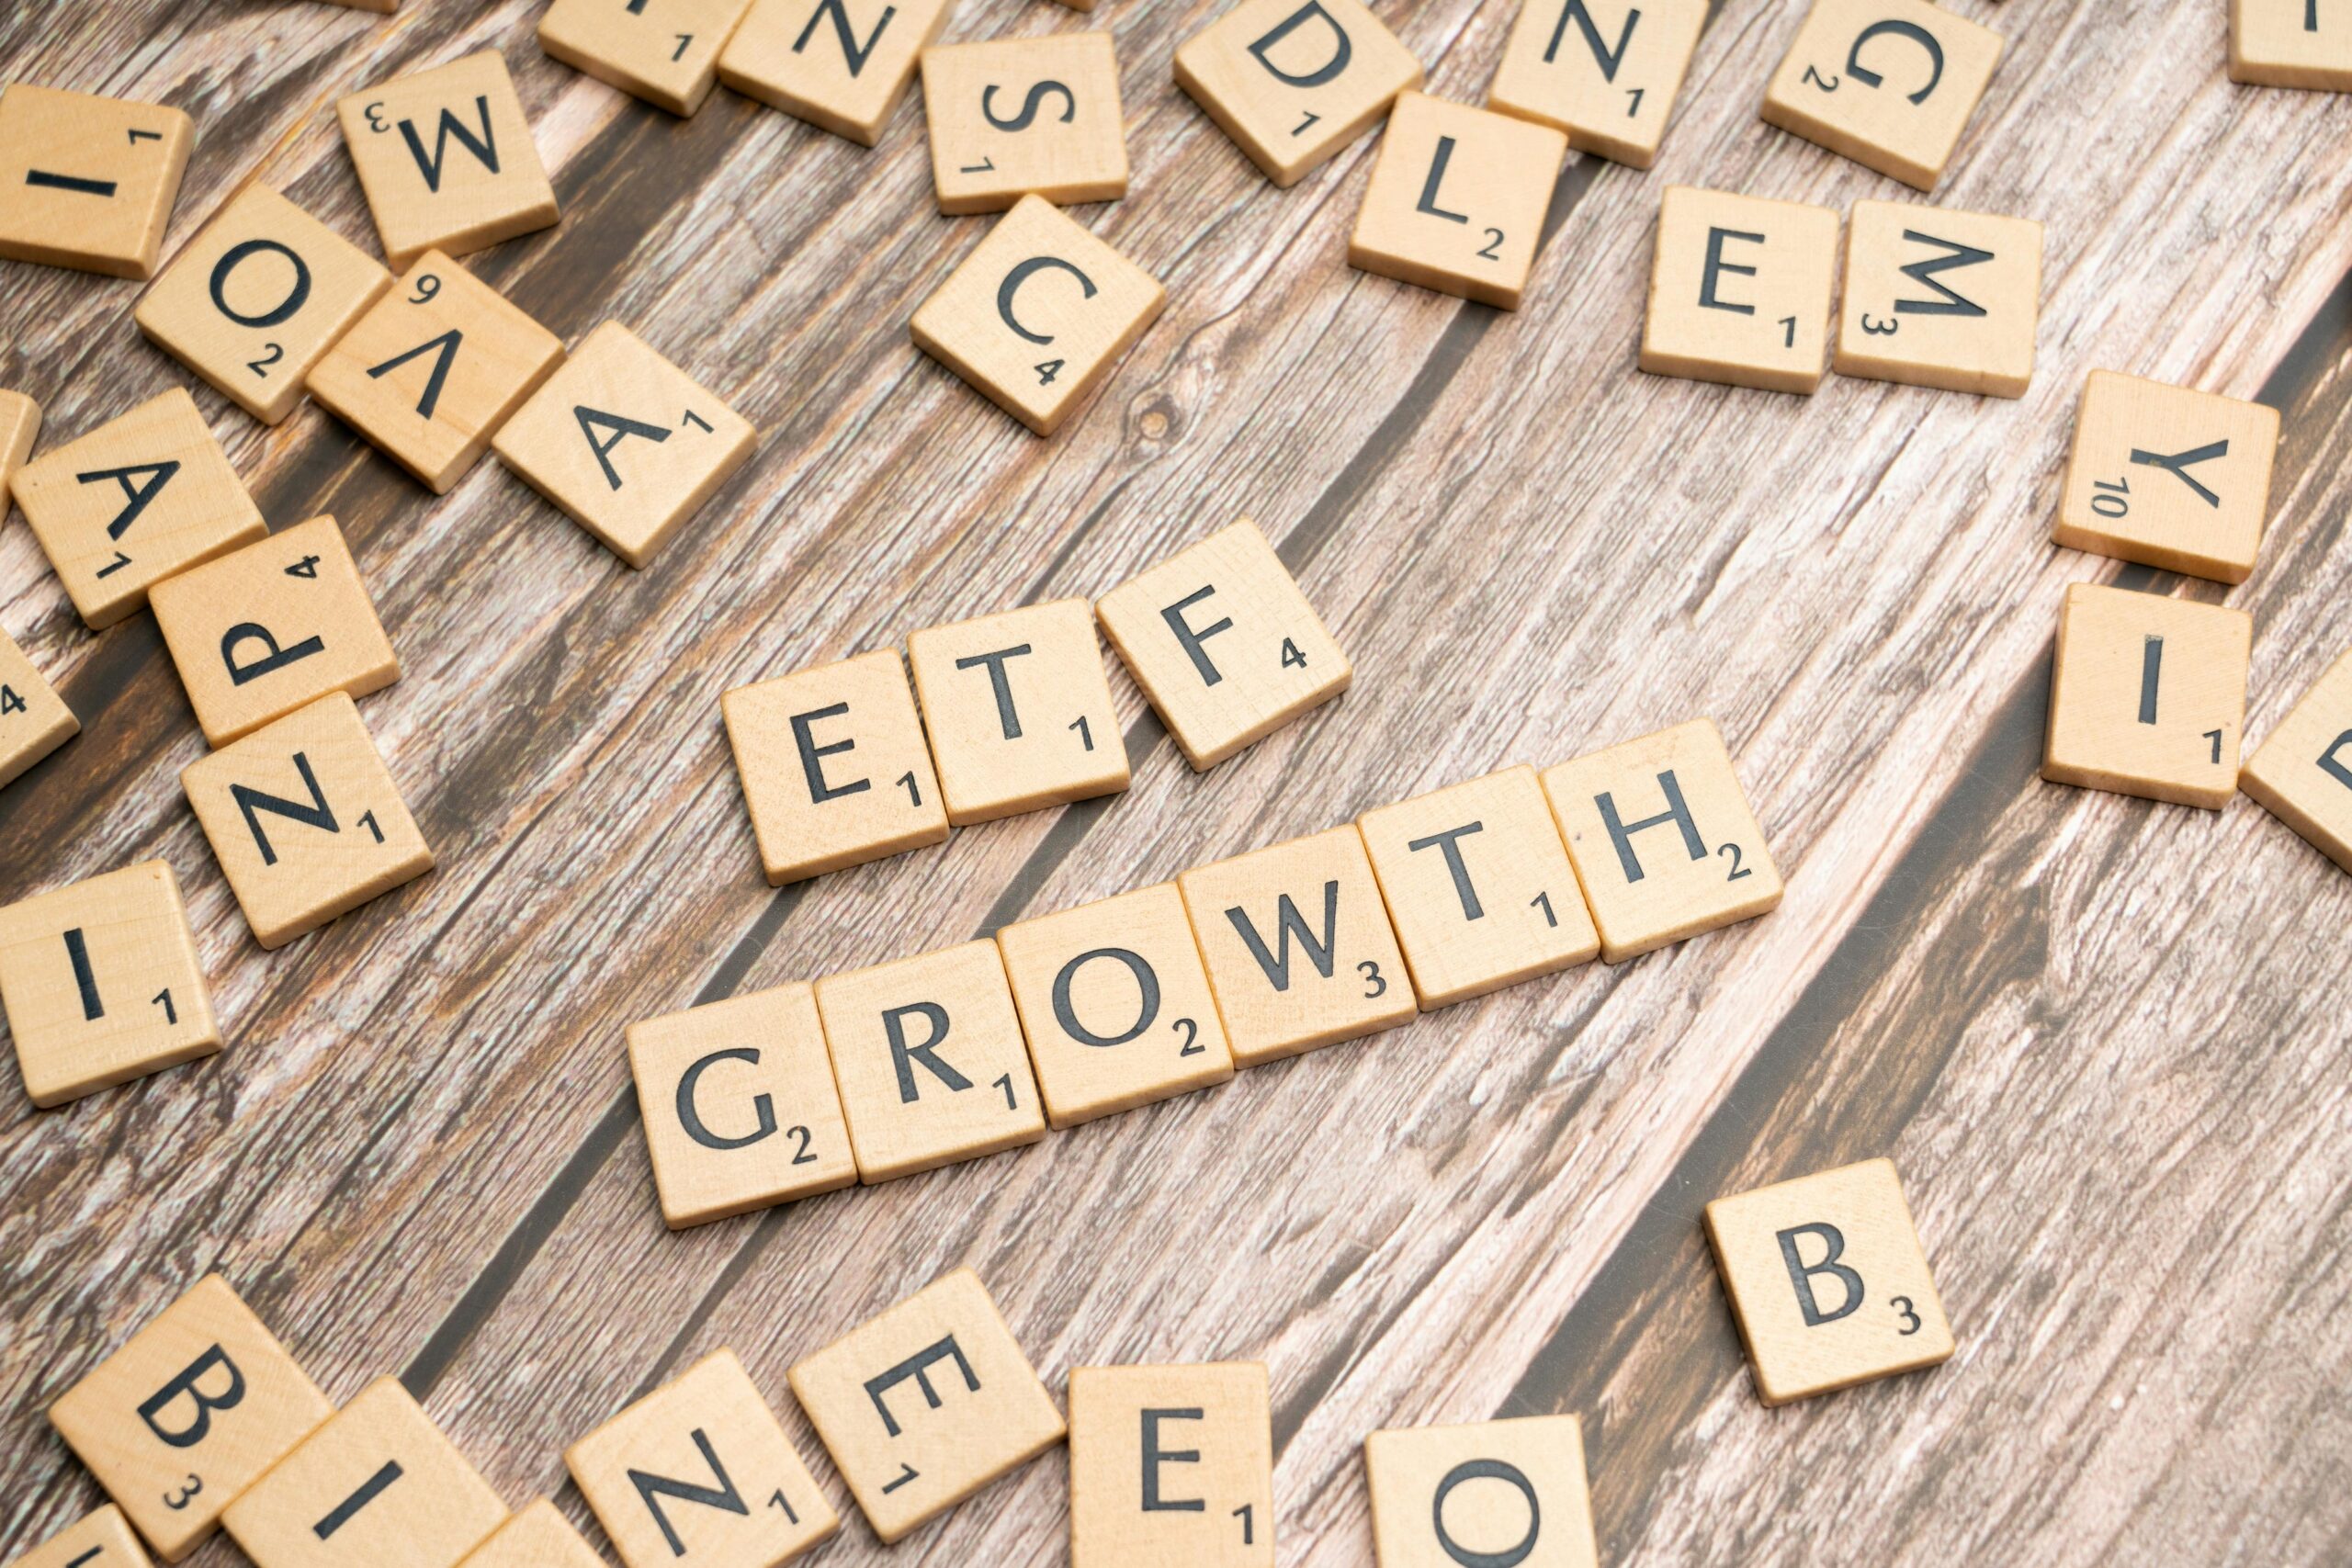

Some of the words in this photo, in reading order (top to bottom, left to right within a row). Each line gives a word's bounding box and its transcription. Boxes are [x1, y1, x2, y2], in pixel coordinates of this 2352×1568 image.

[671, 34, 695, 62] 1
[791, 0, 897, 78] N
[1247, 0, 1352, 88] D
[1543, 0, 1642, 84] N
[1626, 88, 1645, 118] 1
[1845, 18, 1945, 106] G
[981, 80, 1076, 132] S
[1801, 64, 1839, 94] 2
[363, 101, 391, 134] 3
[1291, 110, 1321, 137] 1
[25, 169, 118, 197] I
[127, 128, 163, 145] 1
[959, 156, 995, 174] 1
[1416, 135, 1469, 225] L
[1476, 227, 1505, 262] 2
[209, 239, 311, 329] O
[996, 255, 1098, 346] C
[1698, 226, 1766, 316] E
[1778, 315, 1797, 349] 1
[1893, 229, 1996, 317] M
[1860, 312, 1899, 336] 3
[246, 342, 284, 378] 2
[366, 328, 464, 421] V
[1034, 358, 1066, 387] 4
[572, 404, 673, 491] A
[682, 409, 715, 434] 1
[2129, 438, 2230, 509] Y
[75, 460, 181, 542] A
[2090, 476, 2130, 519] 10
[96, 550, 132, 580] 1
[220, 622, 325, 687] P
[284, 555, 321, 580] 4
[1281, 637, 1307, 669] 4
[0, 683, 28, 716] 4
[1068, 715, 1094, 752] 1
[2137, 635, 2164, 726] I
[2201, 728, 2222, 765] 1
[229, 750, 341, 866] N
[356, 808, 386, 844] 1
[895, 770, 922, 807] 1
[1717, 842, 1752, 882] 2
[1530, 890, 1558, 928] 1
[62, 927, 105, 1021] I
[151, 987, 178, 1025] 1
[675, 769, 1709, 1151] GROWTH
[1356, 960, 1387, 999] 3
[1171, 1018, 1206, 1058] 2
[991, 1072, 1018, 1111] 1
[786, 1125, 818, 1166] 2
[1775, 1222, 1865, 1327] B
[1889, 1295, 1922, 1337] 3
[136, 1342, 246, 1449] B
[863, 1333, 981, 1438] E
[163, 1472, 204, 1511] 3
[626, 1427, 751, 1558] N
[767, 1488, 800, 1526] 1
[881, 1462, 920, 1495] 1
[1140, 1407, 1206, 1513] E
[1232, 1503, 1254, 1546] 1
[1432, 1458, 1541, 1568] O
